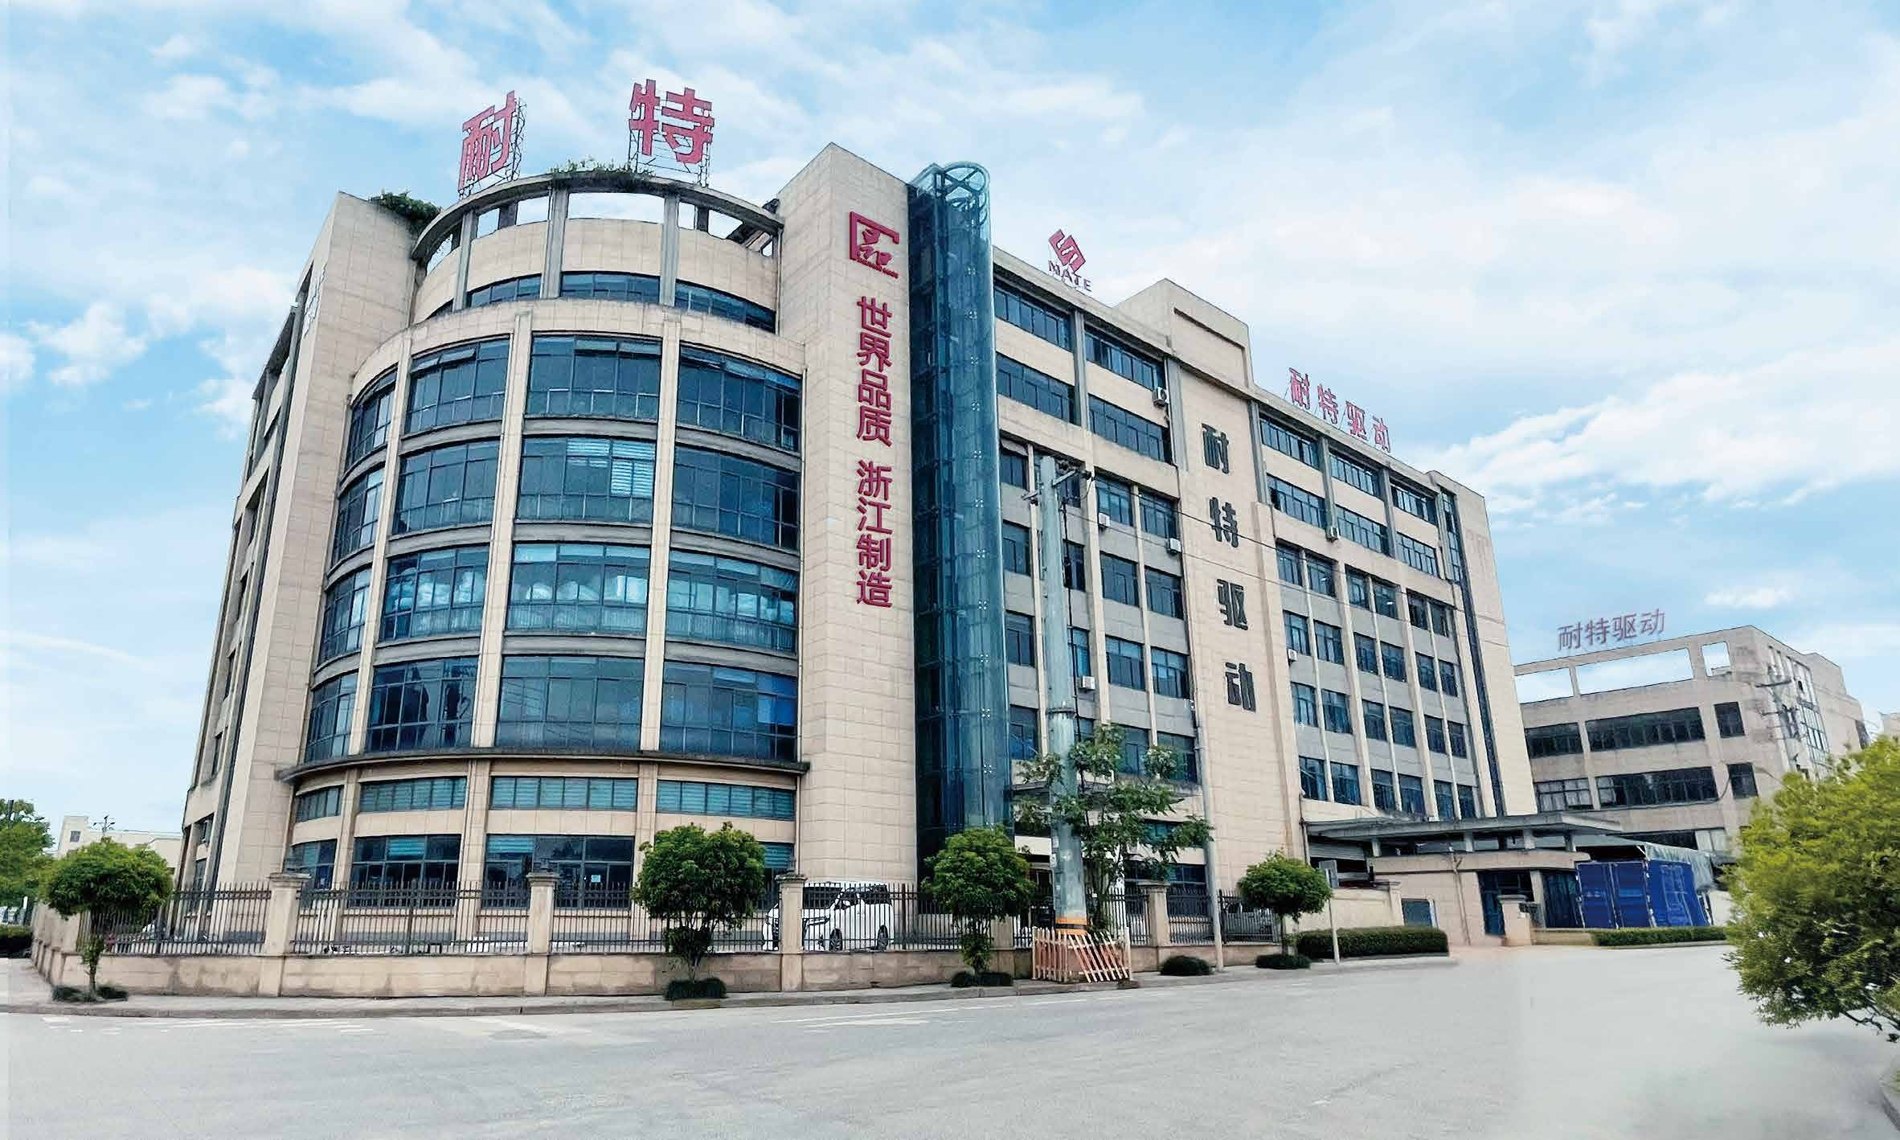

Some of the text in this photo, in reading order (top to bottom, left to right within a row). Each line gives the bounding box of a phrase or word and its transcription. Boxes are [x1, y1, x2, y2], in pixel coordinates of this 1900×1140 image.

[457, 79, 715, 191] 耐特
[1048, 260, 1092, 292] NATE
[856, 295, 893, 448] 世界品质
[1288, 366, 1391, 454] 耐特驱动
[856, 459, 893, 609] 浙江制造
[1200, 422, 1257, 713] 耐特驱动
[1558, 608, 1665, 652] 耐特驱动
